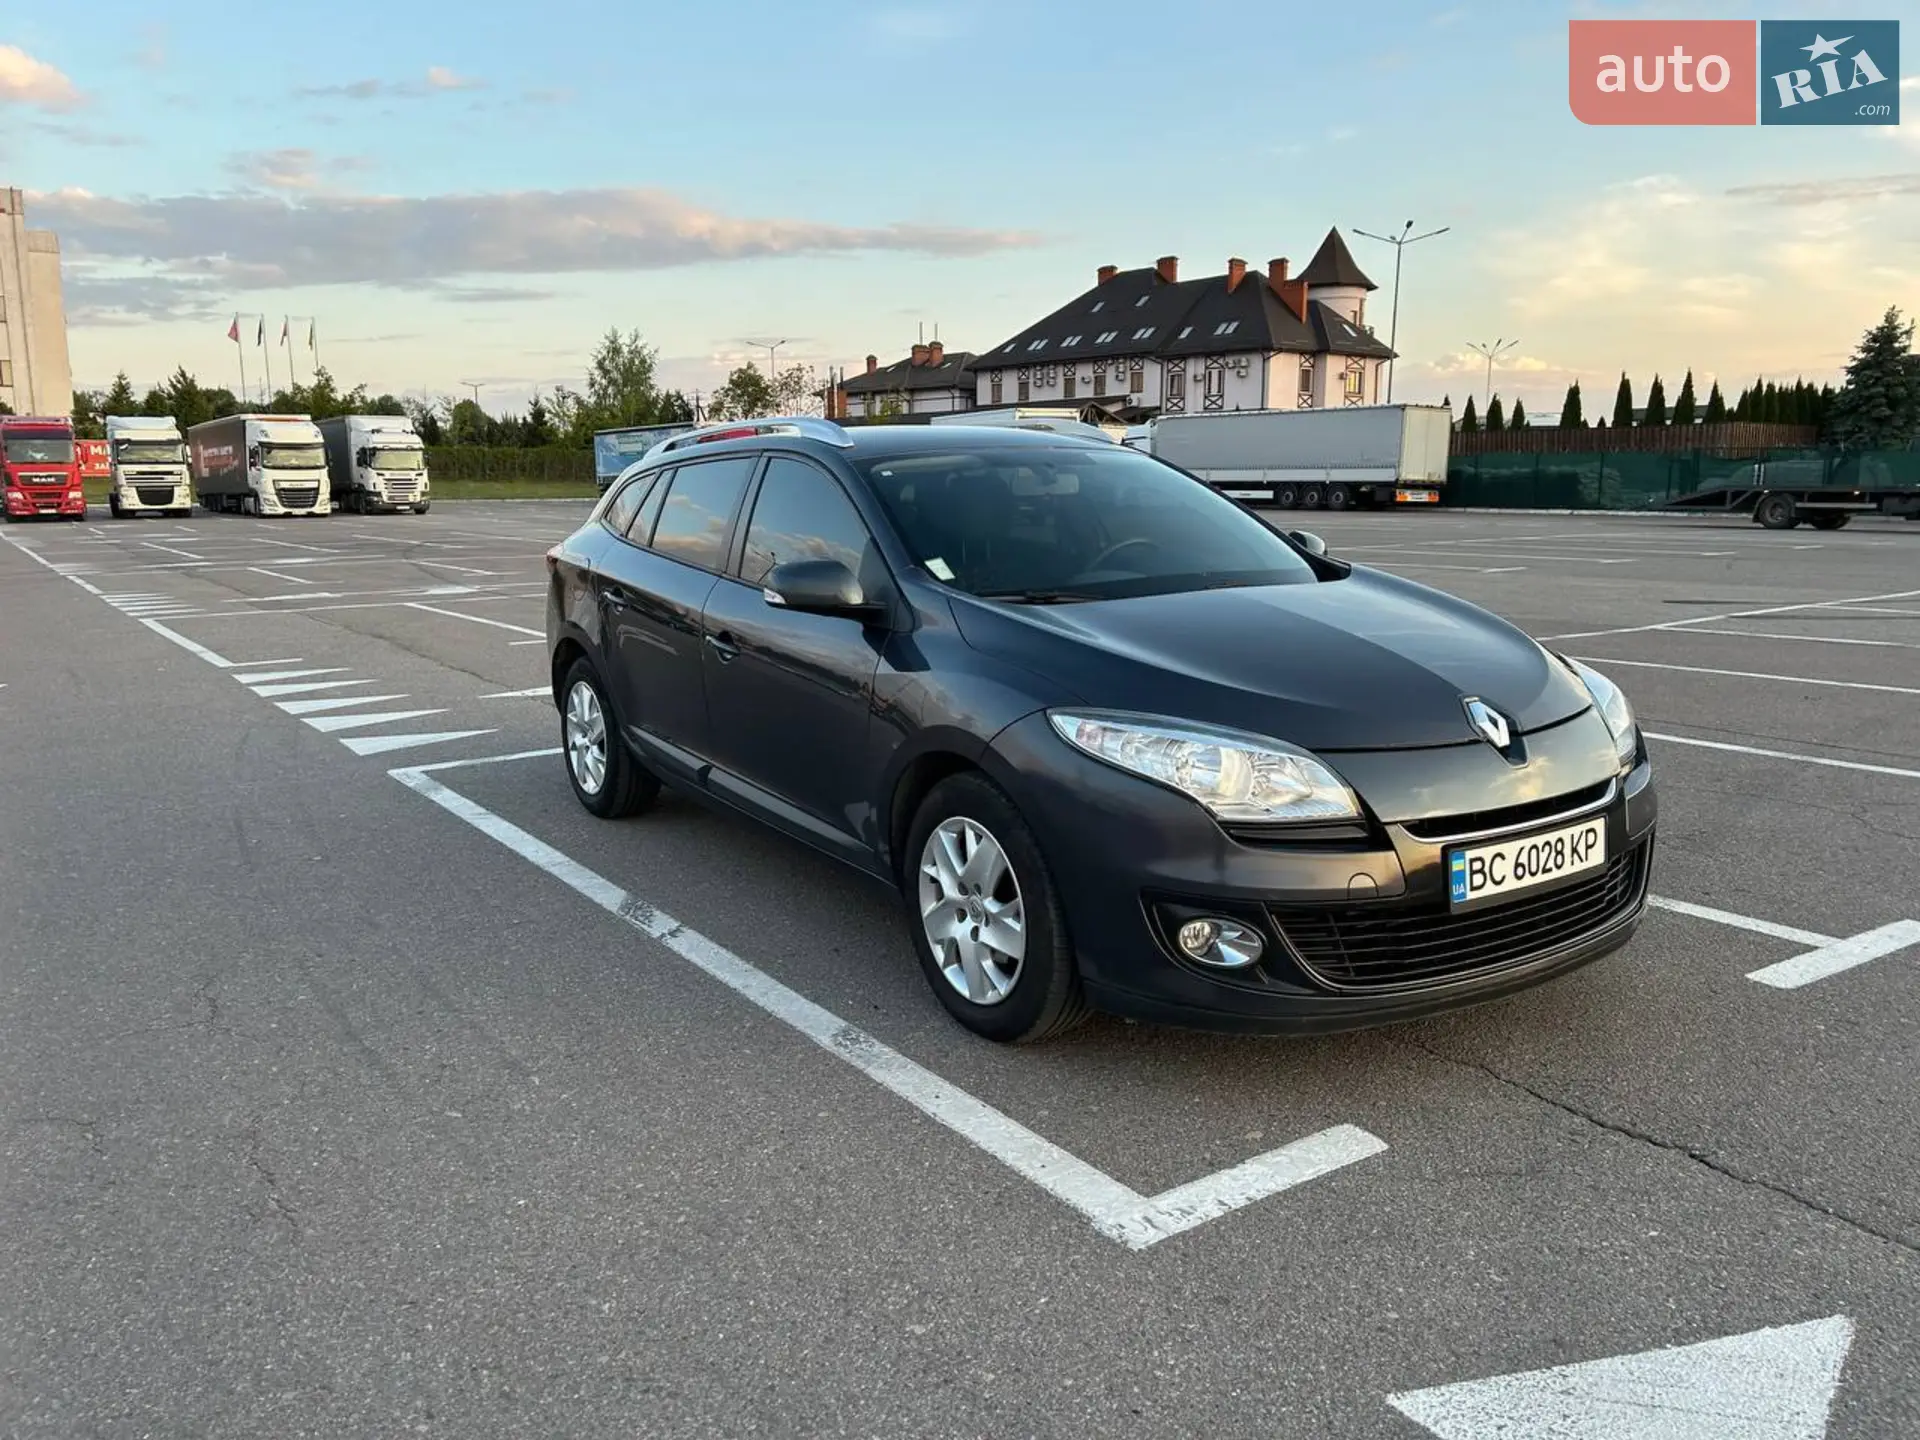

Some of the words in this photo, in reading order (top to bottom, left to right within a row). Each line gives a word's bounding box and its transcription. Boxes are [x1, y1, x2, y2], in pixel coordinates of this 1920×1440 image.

[1469, 852, 1506, 892] BC
[1513, 837, 1565, 881] 6028
[1570, 827, 1598, 867] KP
[1452, 883, 1465, 895] UA
